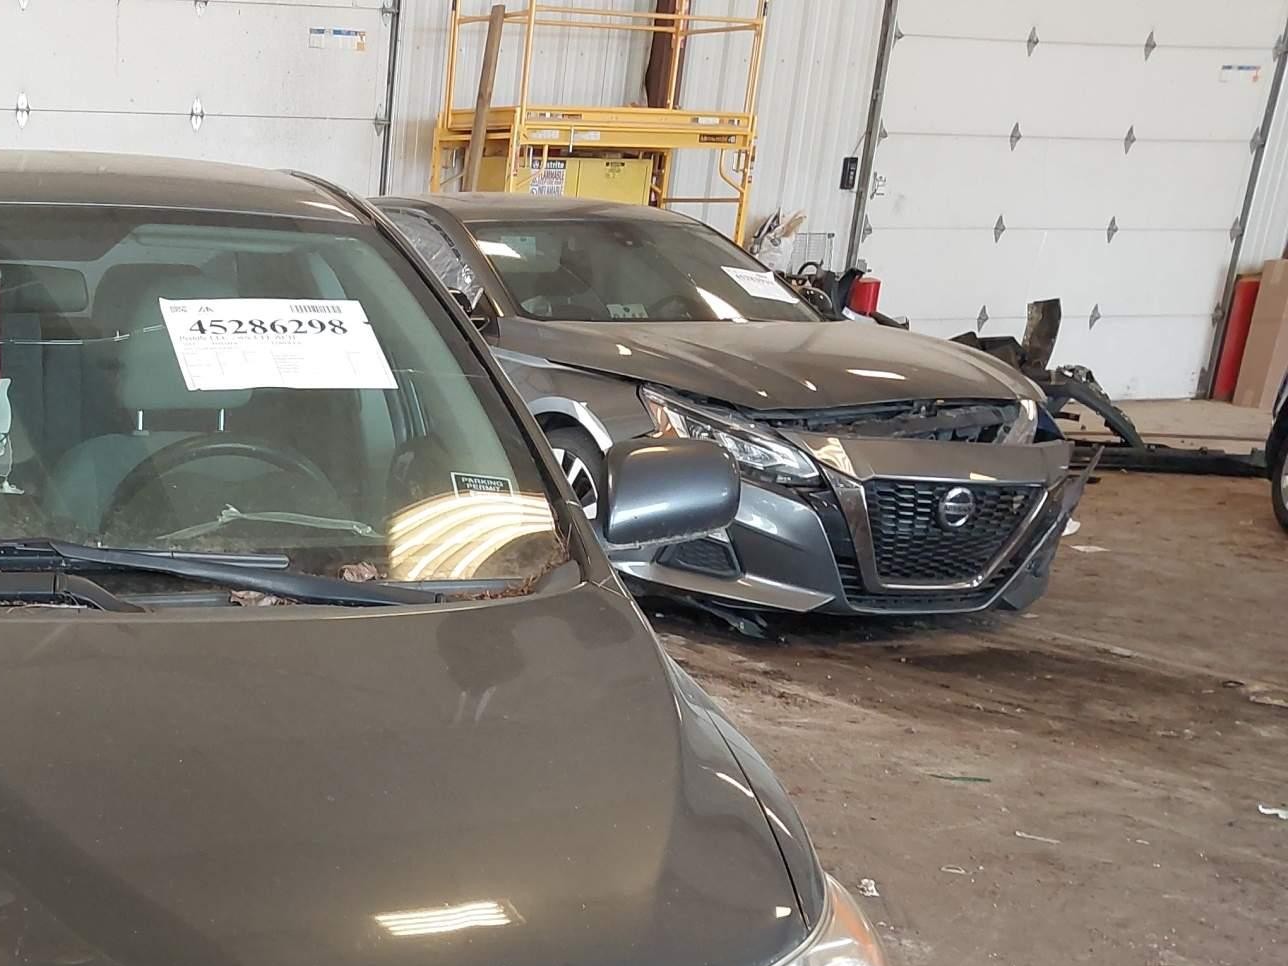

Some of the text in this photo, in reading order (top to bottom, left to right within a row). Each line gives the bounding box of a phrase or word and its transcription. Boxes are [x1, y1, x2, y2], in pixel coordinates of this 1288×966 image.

[189, 319, 348, 335] 45286298
[461, 477, 504, 487] PARKING
[466, 483, 501, 492] PERMIT
